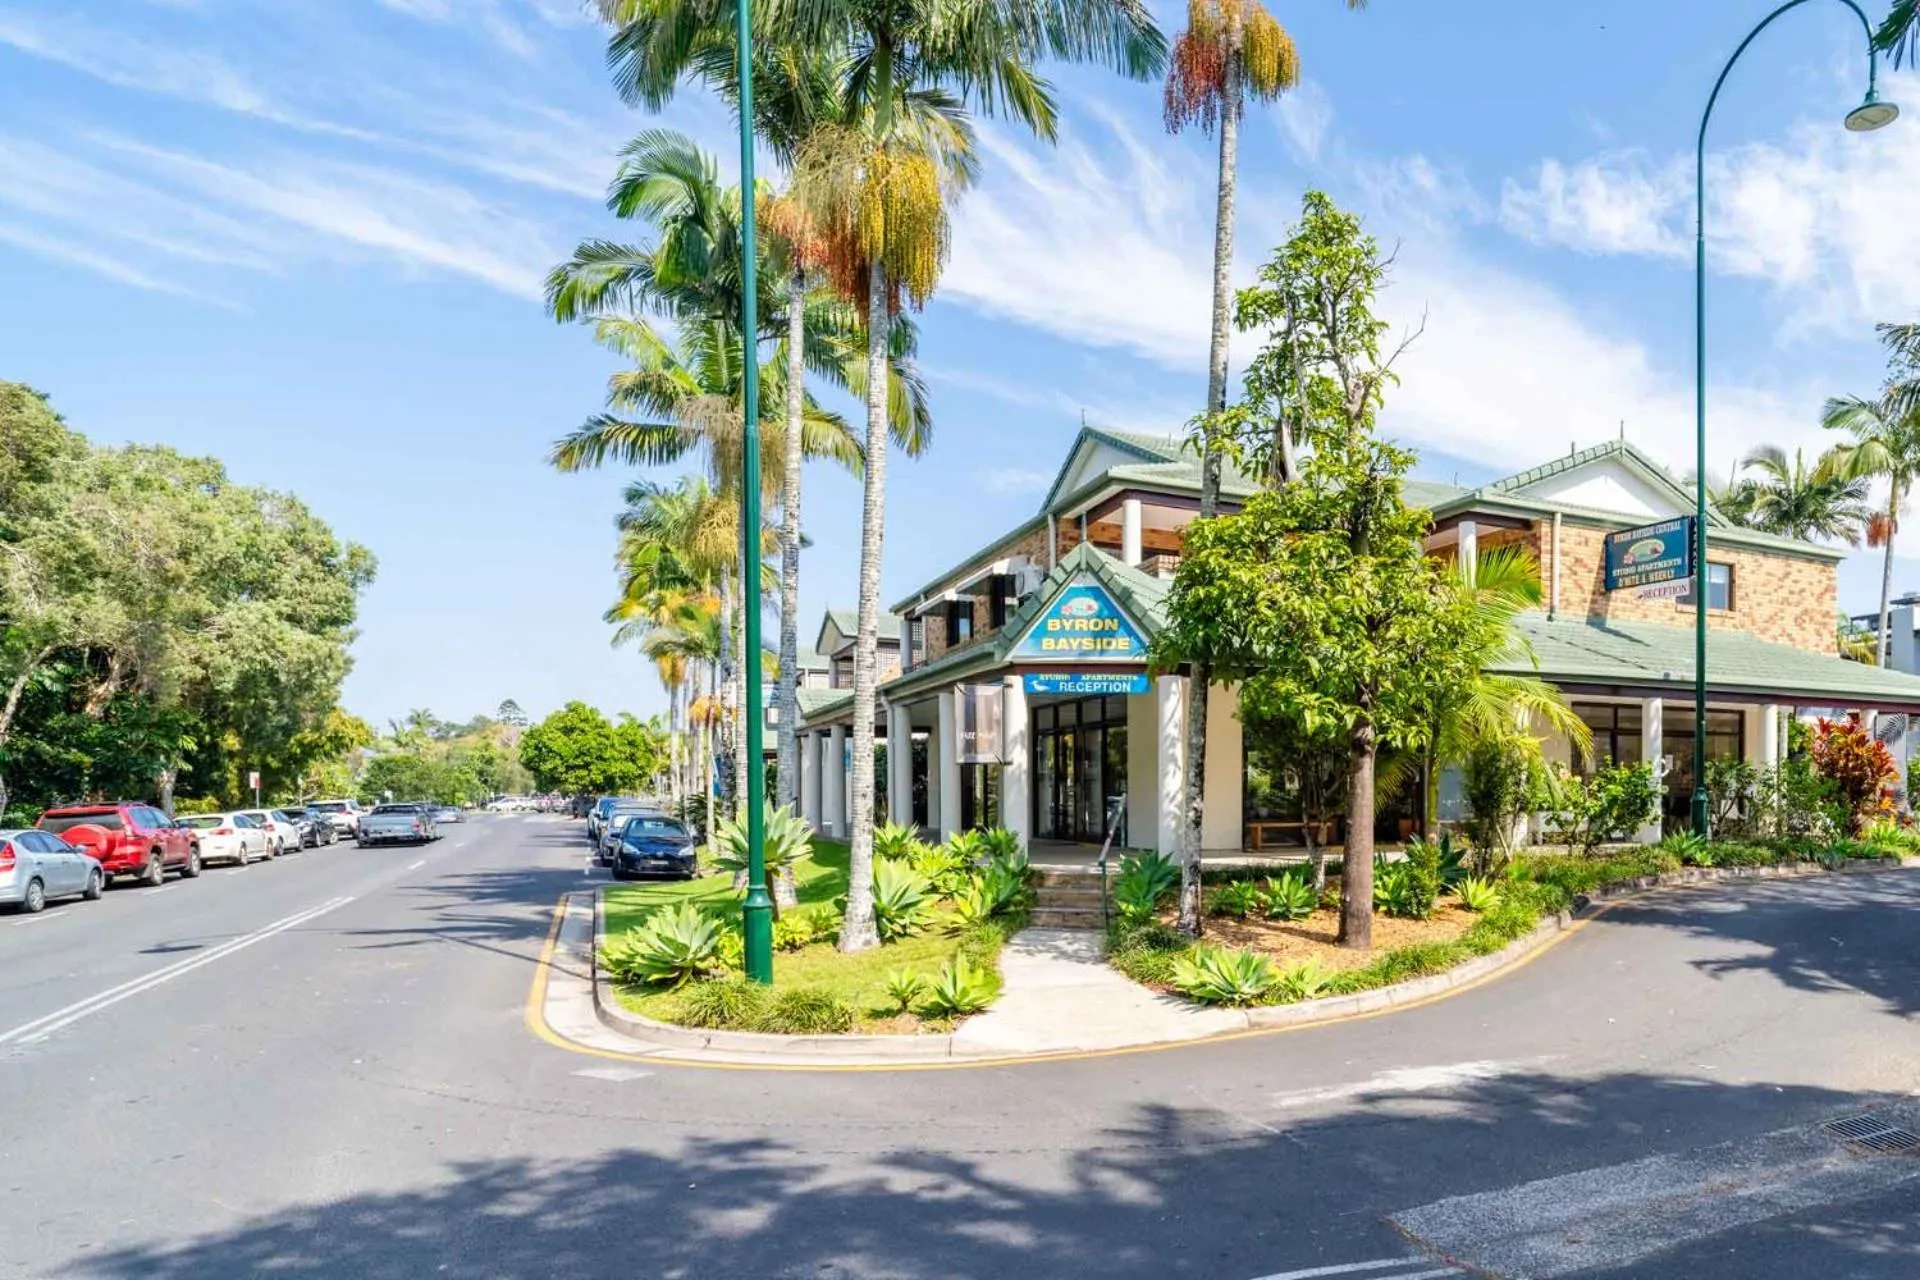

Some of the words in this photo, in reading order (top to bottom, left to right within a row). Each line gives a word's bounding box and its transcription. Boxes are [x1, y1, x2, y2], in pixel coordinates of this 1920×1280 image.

[1637, 558, 1681, 571] APARTMENTS
[1642, 584, 1687, 598] RECEPTION
[1047, 618, 1119, 631] BYRON
[1042, 637, 1131, 650] BAYSIDE
[1059, 681, 1131, 692] RECEPTION
